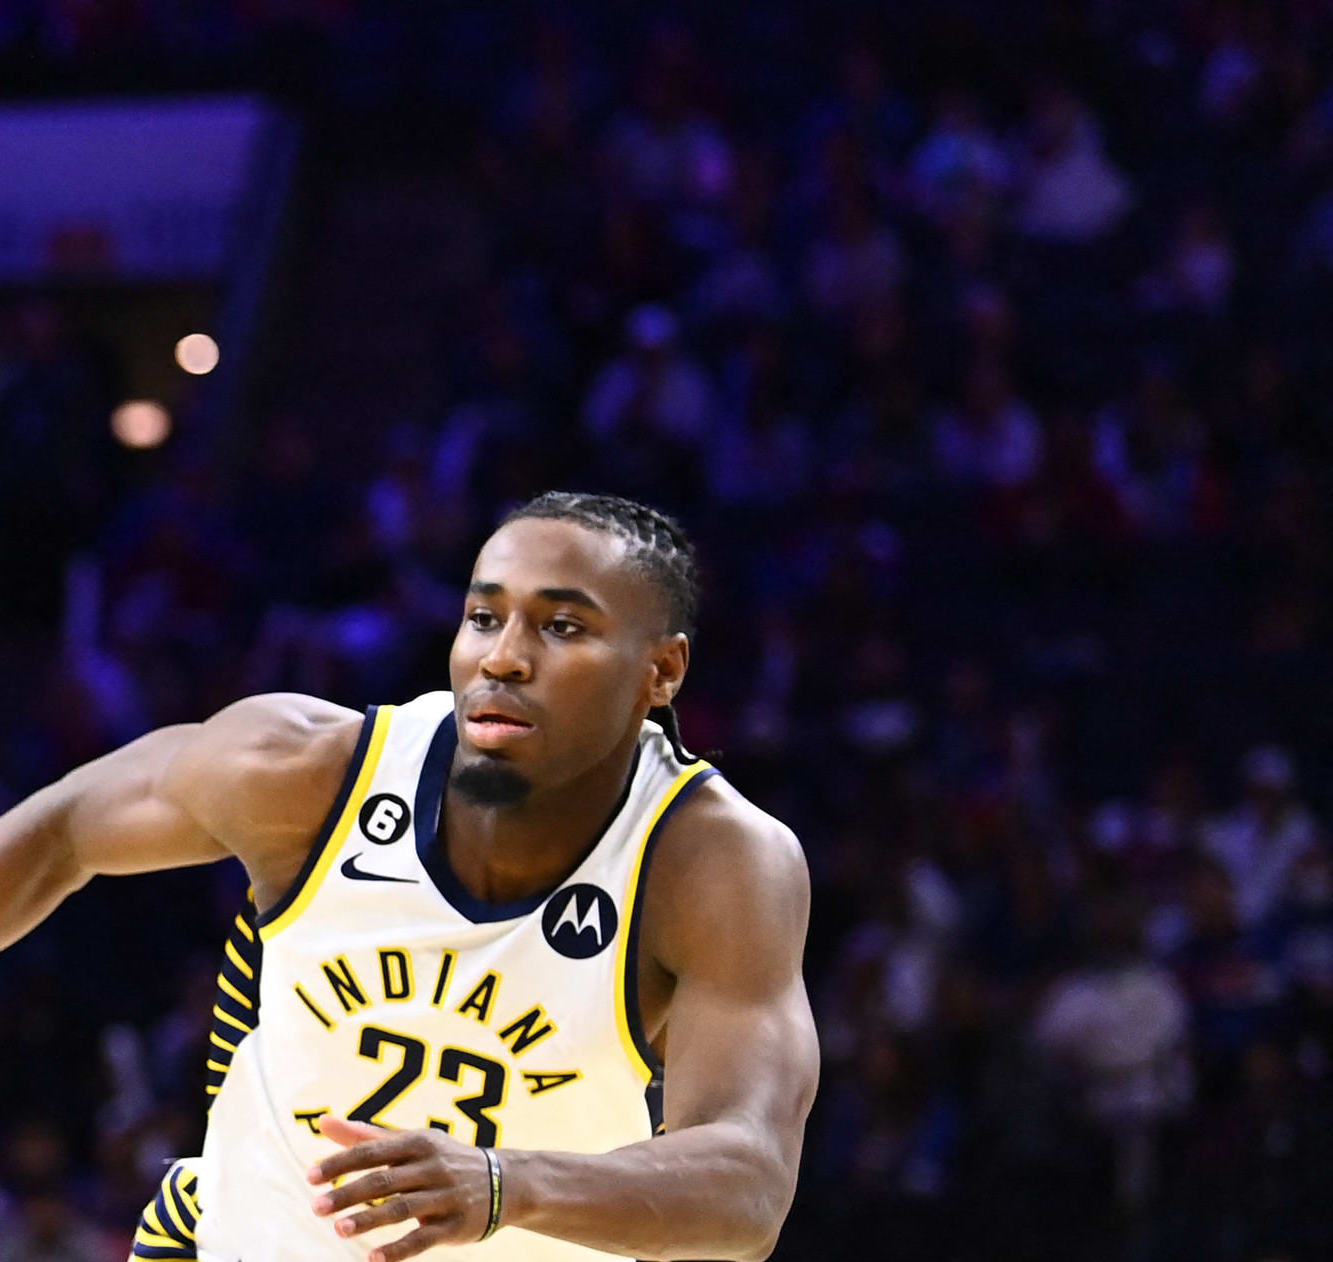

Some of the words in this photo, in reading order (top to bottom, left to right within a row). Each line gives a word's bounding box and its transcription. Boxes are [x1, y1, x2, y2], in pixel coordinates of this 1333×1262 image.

[366, 800, 404, 840] 6
[293, 946, 583, 1098] INDIANA
[344, 1025, 511, 1150] 23
